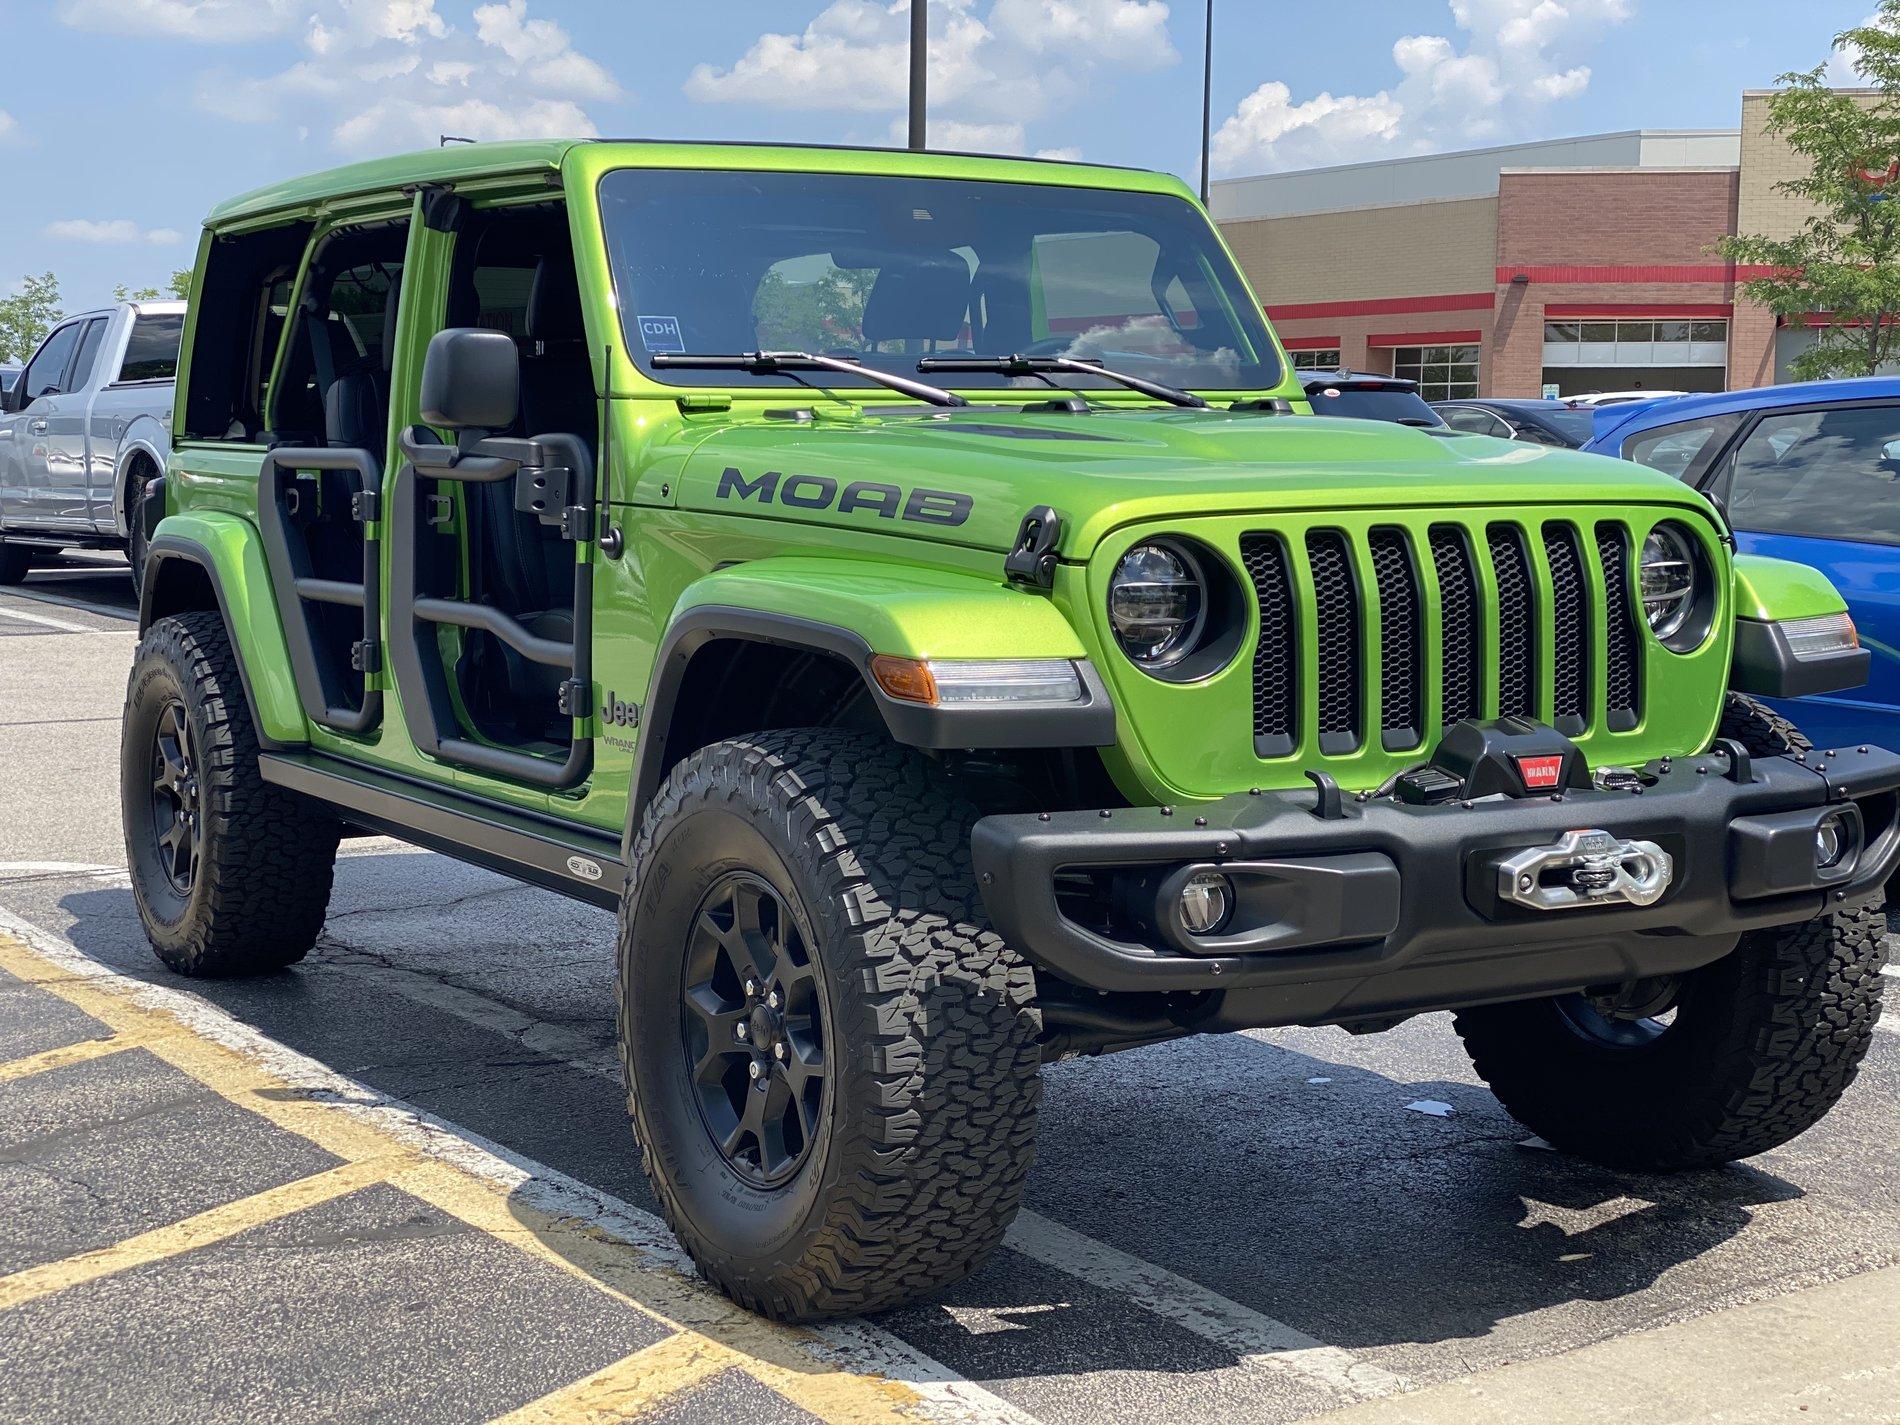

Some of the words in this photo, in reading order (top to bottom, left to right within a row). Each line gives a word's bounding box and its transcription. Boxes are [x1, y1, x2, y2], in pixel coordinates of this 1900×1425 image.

[643, 322, 676, 335] CDH
[715, 466, 974, 527] MOAB
[600, 690, 639, 728] Jee
[1527, 766, 1556, 778] WARN
